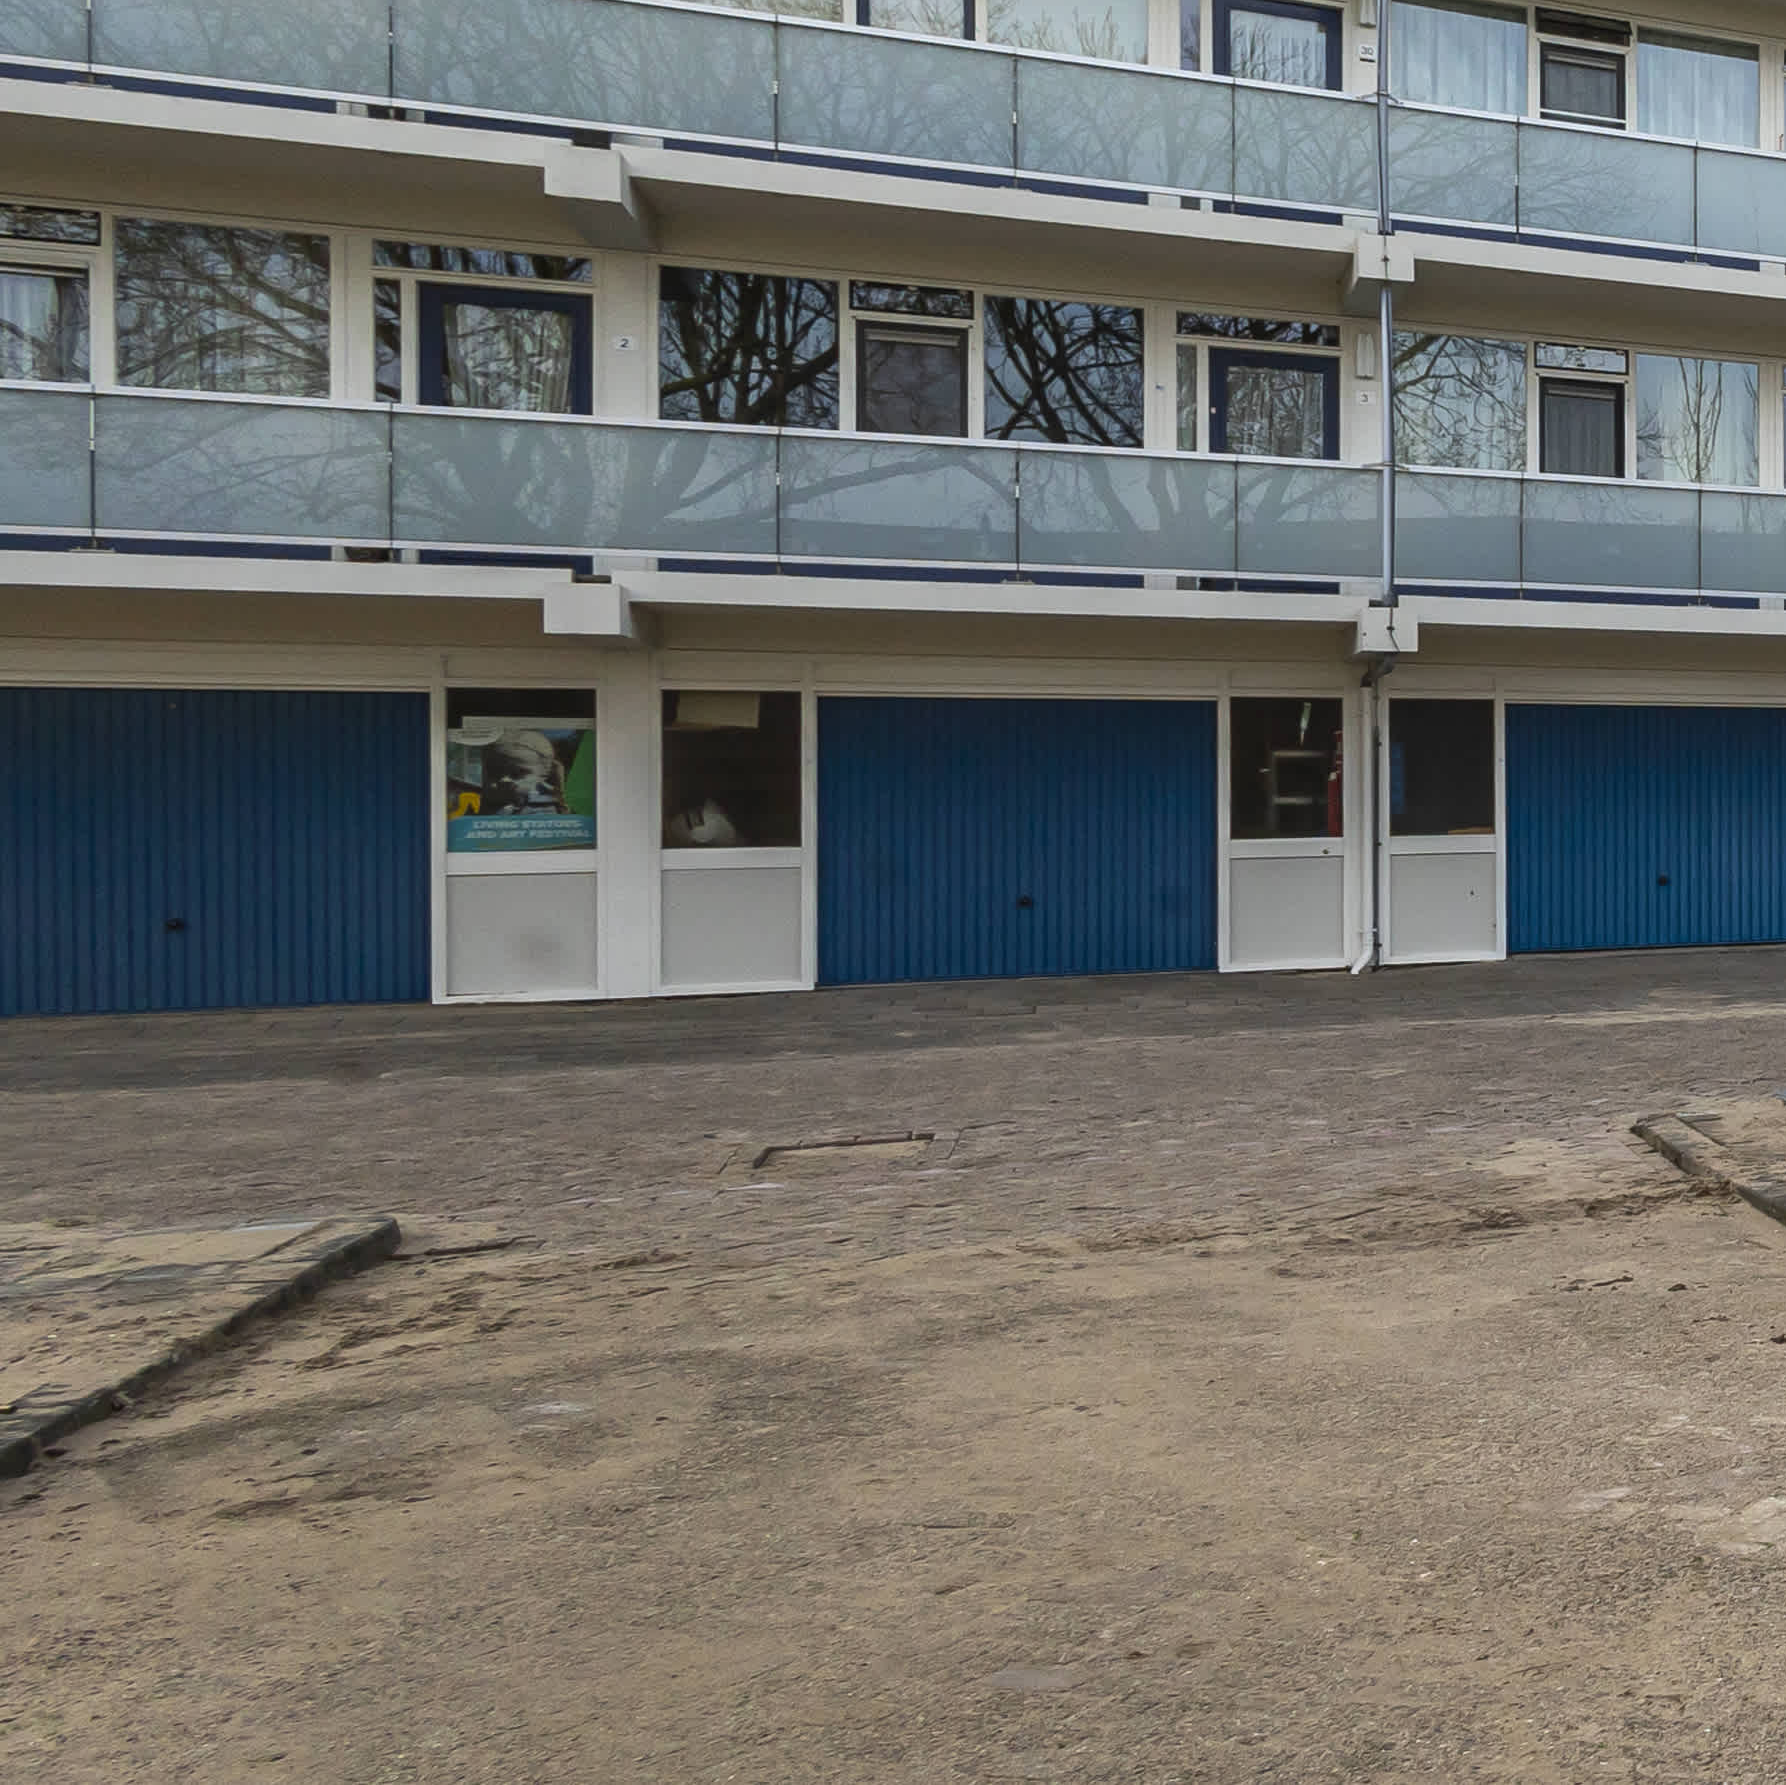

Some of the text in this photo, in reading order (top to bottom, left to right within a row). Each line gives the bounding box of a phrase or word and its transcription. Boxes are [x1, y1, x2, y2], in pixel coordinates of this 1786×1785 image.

[1360, 45, 1374, 56] 30
[619, 337, 630, 349] 2
[1360, 392, 1369, 403] 3
[464, 830, 497, 839] AND
[499, 830, 529, 839] ART
